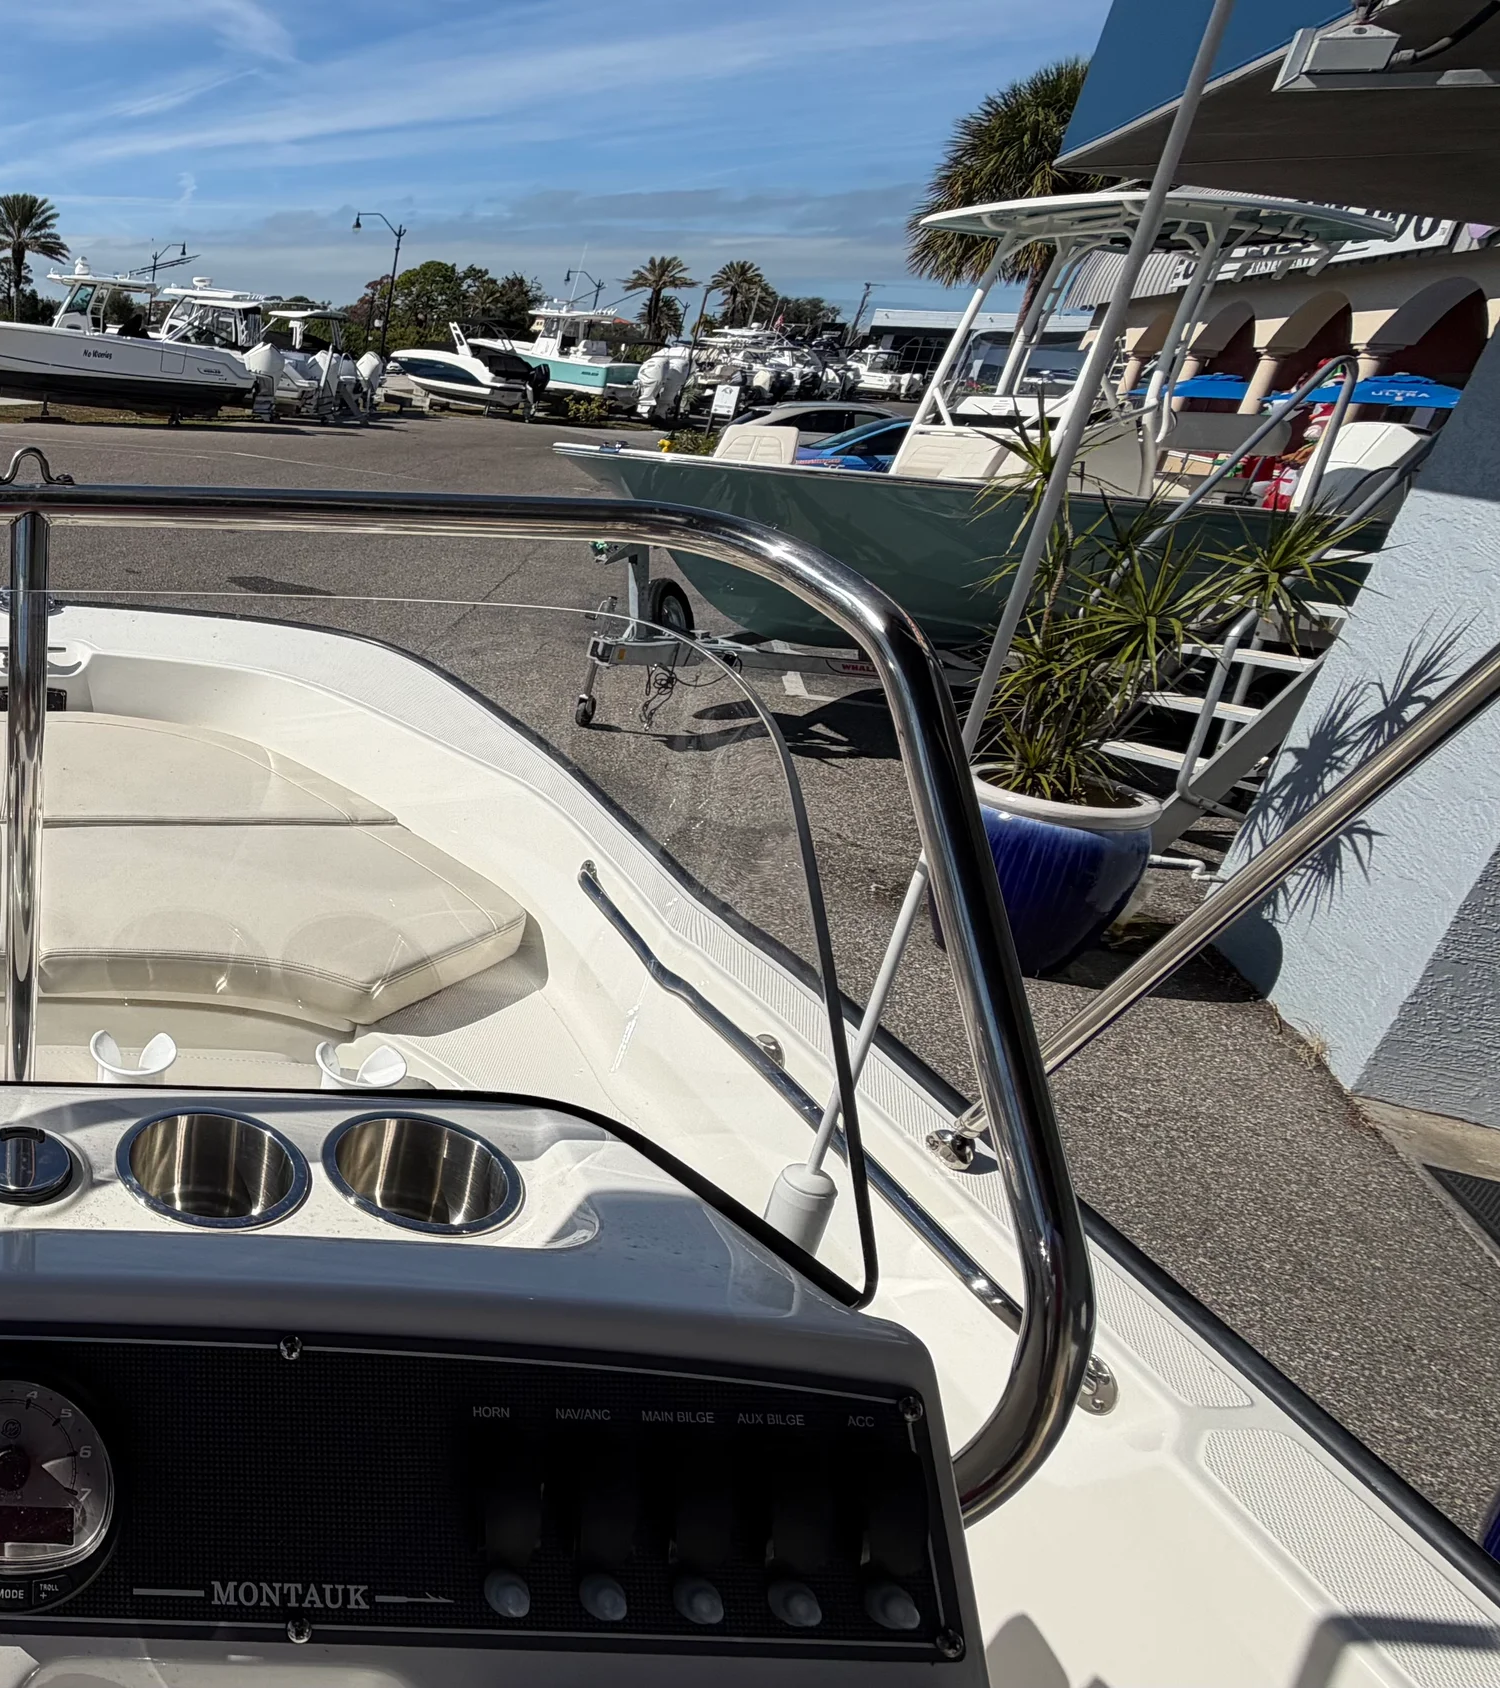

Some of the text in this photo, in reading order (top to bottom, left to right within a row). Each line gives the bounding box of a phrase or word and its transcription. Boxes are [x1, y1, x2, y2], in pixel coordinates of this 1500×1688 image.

[83, 349, 113, 360] No Worries
[26, 1390, 39, 1399] 4
[60, 1408, 72, 1418] 5
[473, 1406, 875, 1427] HORN NAV/ANC MAIN BILGE AUX BILGE ACC
[79, 1445, 92, 1458] 6
[80, 1488, 92, 1502] 7
[40, 1583, 59, 1591] TROLL
[211, 1580, 370, 1609] MONTAUK
